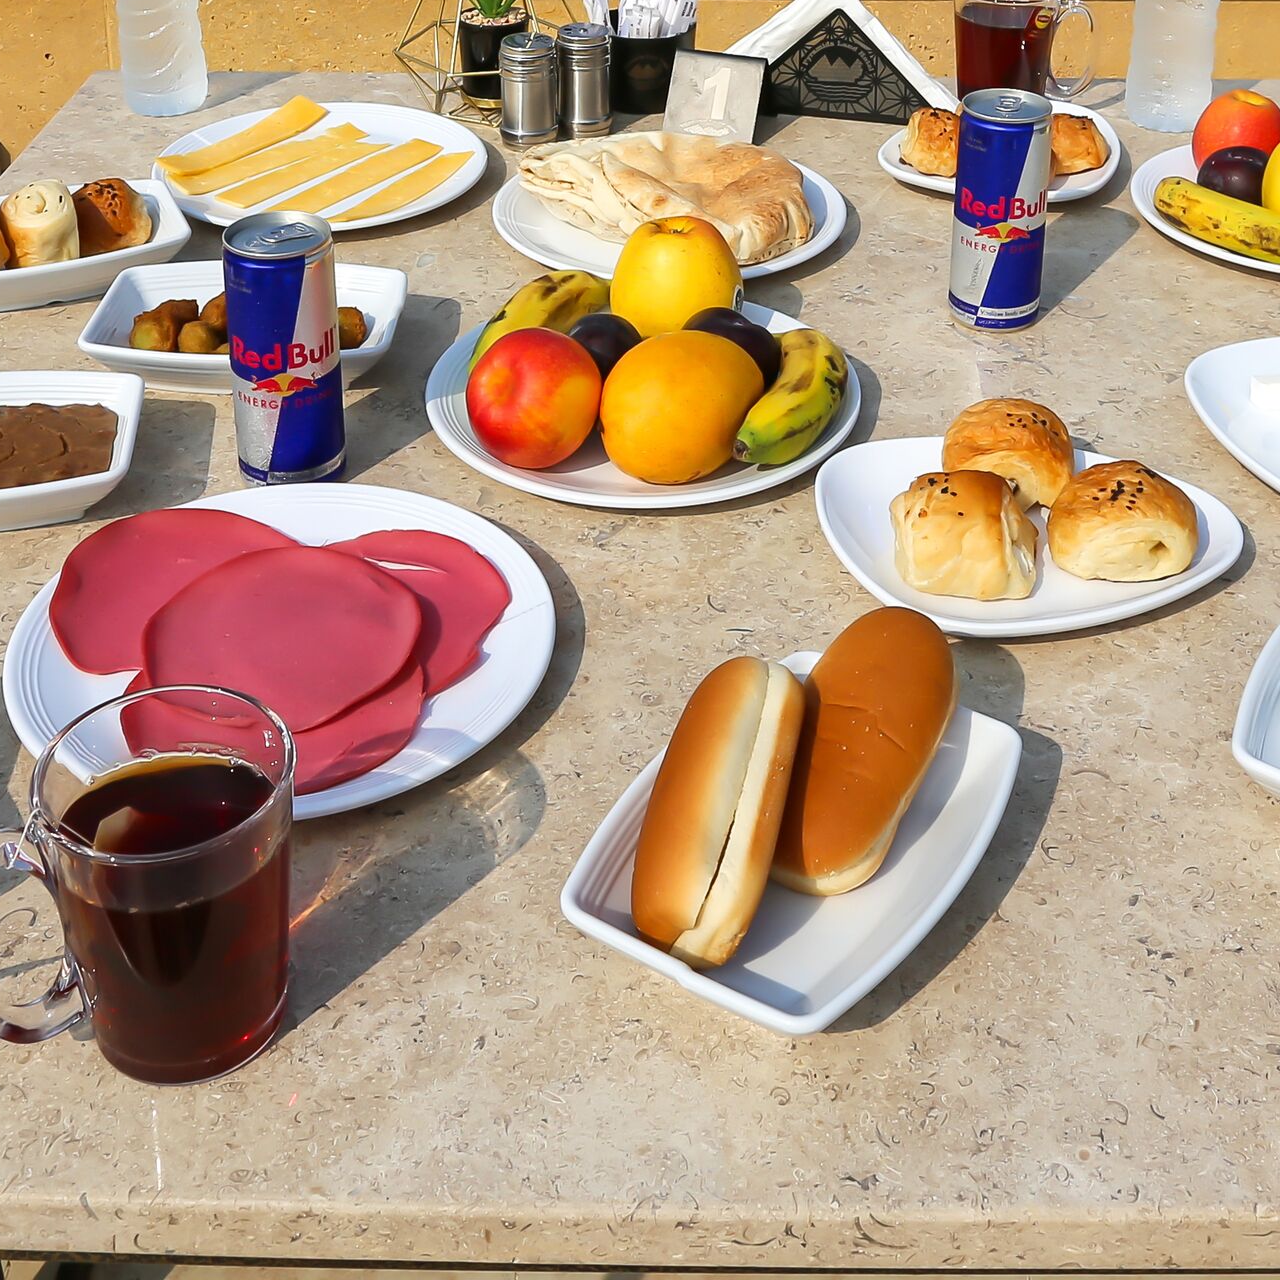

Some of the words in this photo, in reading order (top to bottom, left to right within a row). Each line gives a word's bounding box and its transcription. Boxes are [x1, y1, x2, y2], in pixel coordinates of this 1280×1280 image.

[702, 67, 731, 121] 1
[960, 187, 1005, 220] Red
[1009, 189, 1046, 220] Bull
[232, 335, 282, 370] Red
[287, 328, 334, 369] Bull
